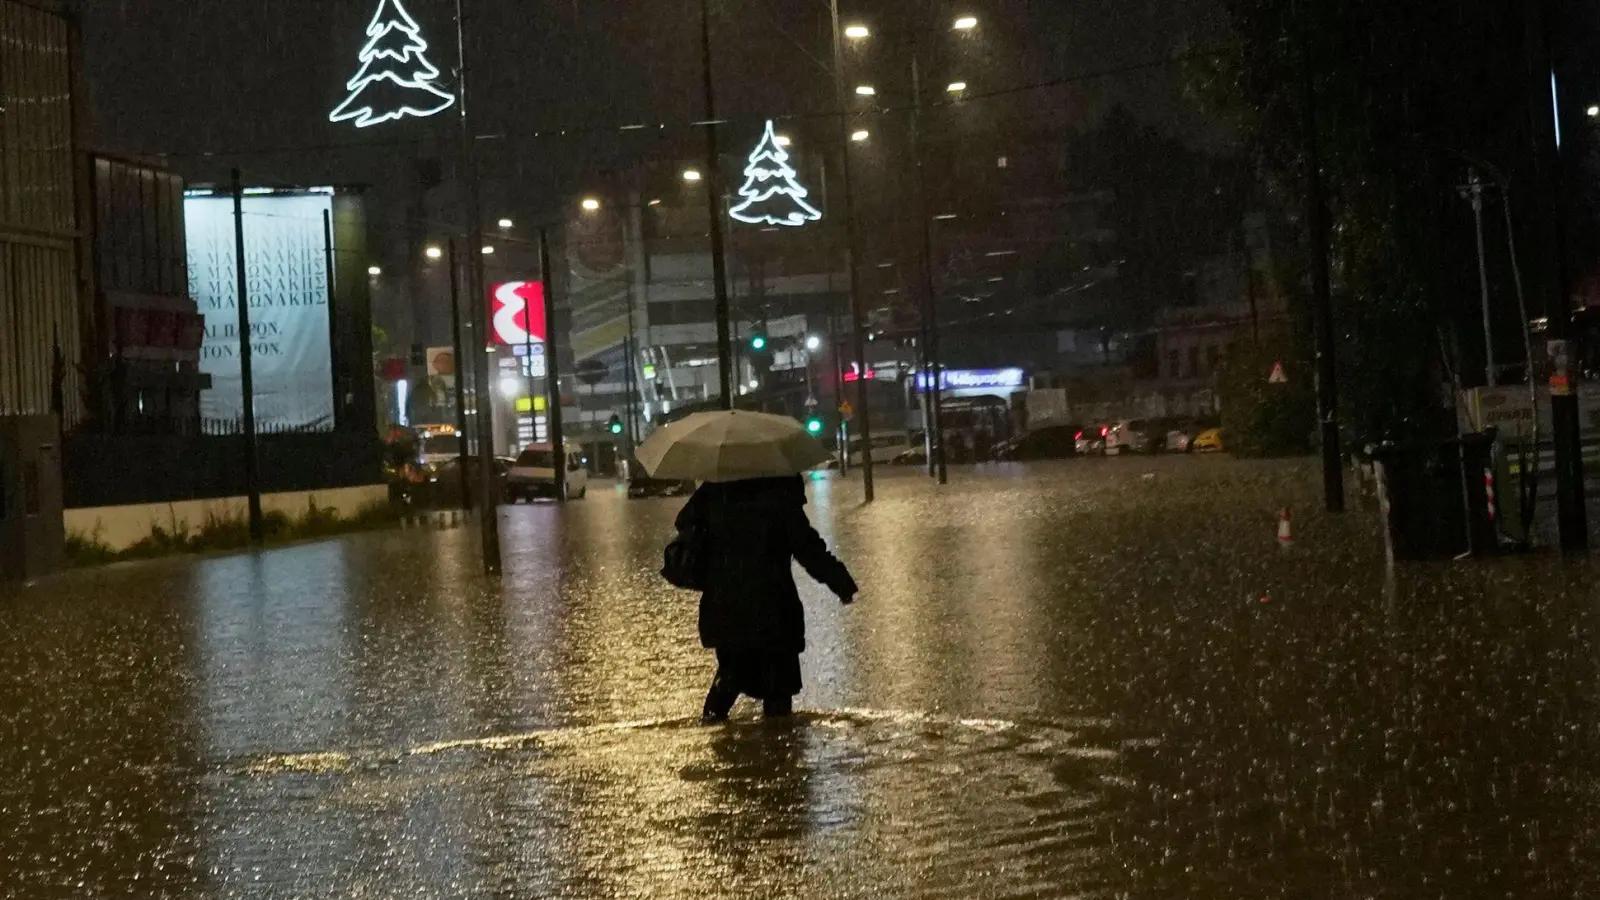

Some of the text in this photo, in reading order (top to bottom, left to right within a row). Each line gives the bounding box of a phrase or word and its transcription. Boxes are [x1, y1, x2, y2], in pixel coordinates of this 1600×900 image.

[208, 262, 324, 280] ΜΑΩΝΑΚΗΣ
[208, 276, 325, 296] ΜΑΩΝΑΚΗΣ
[209, 291, 327, 310] ΜΑΩΝΑΚΗΣ
